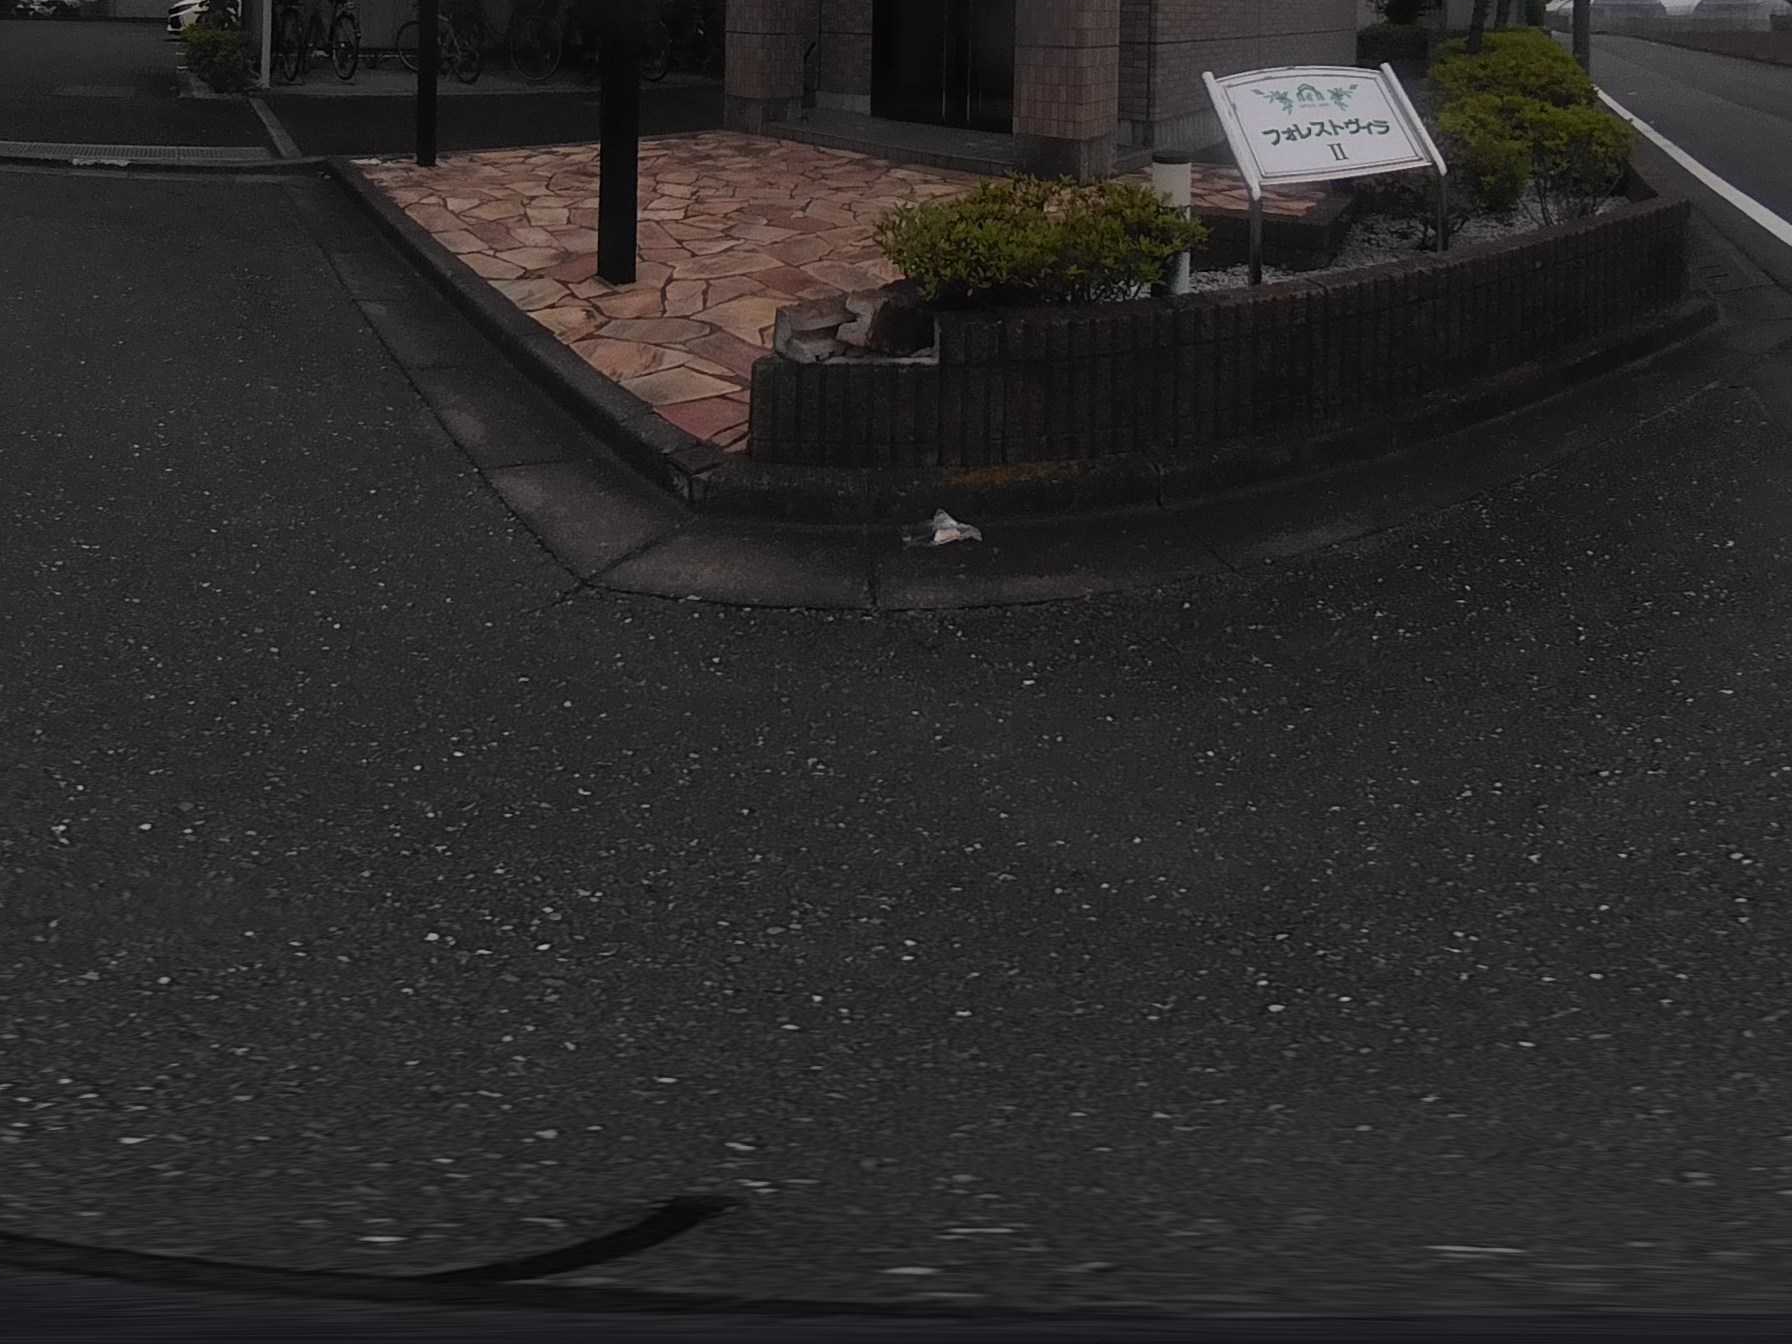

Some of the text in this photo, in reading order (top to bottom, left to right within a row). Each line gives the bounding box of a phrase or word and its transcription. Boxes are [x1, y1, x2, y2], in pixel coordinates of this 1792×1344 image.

[1261, 118, 1390, 146] フォレストヴィラ
